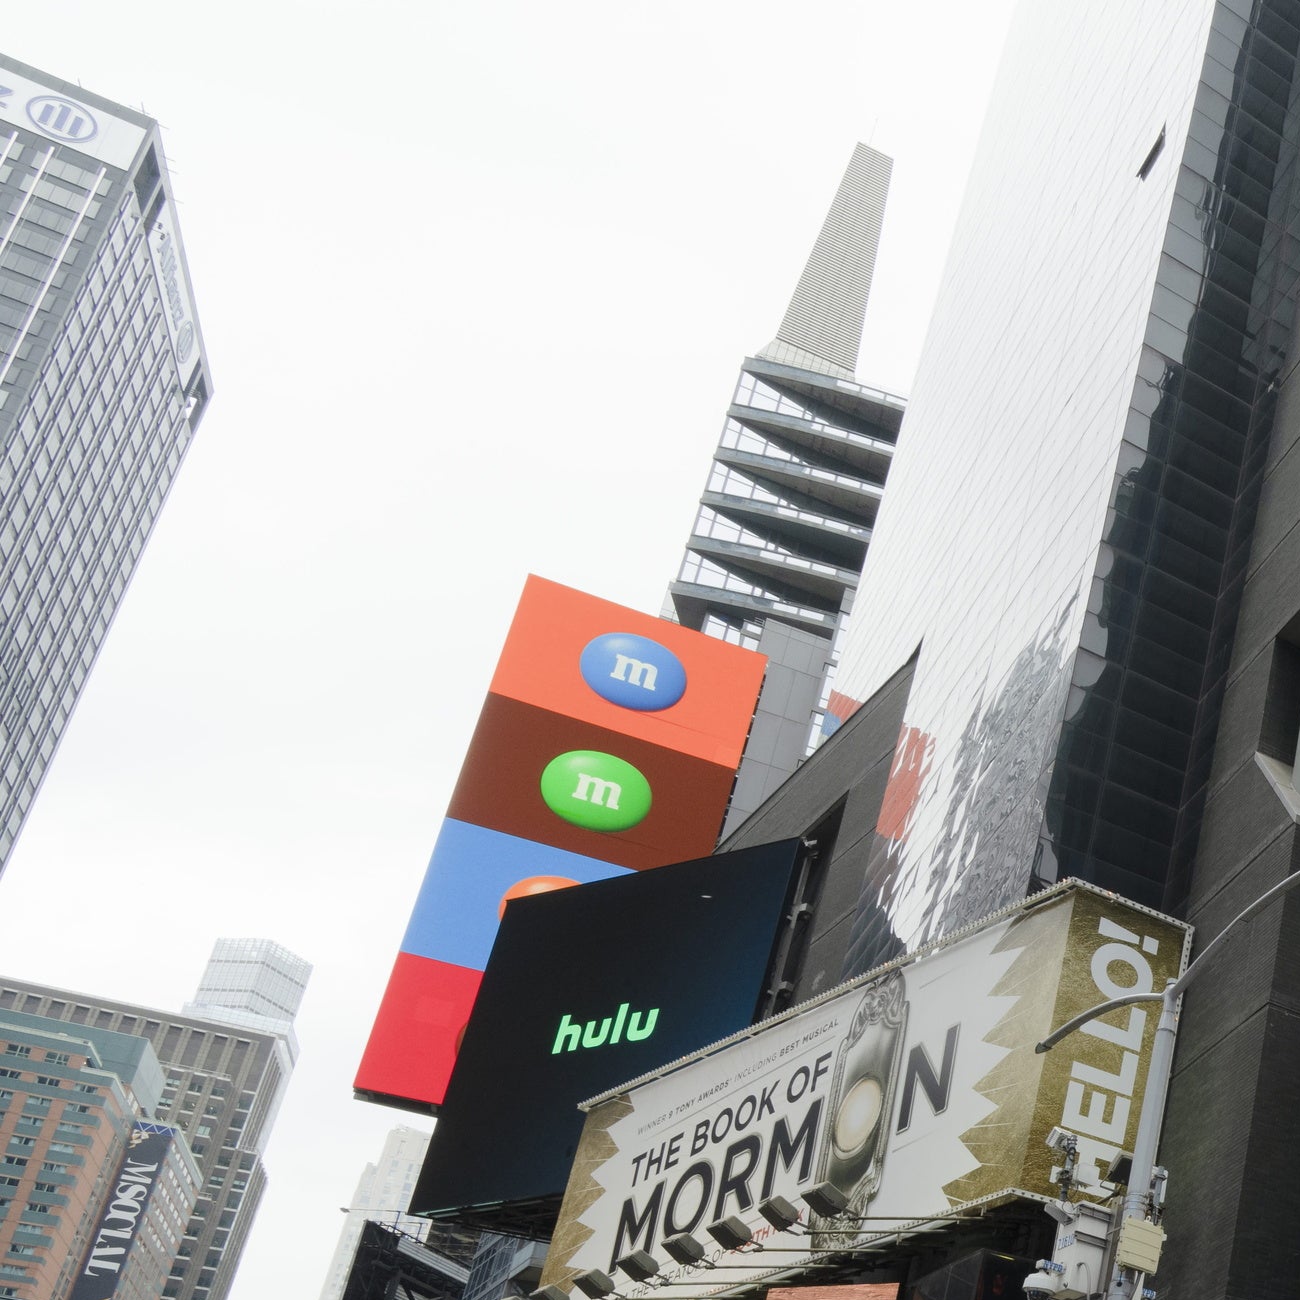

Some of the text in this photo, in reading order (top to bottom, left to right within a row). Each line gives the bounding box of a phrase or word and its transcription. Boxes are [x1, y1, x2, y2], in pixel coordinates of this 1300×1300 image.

[610, 652, 657, 692] m
[571, 770, 623, 811] m
[551, 1002, 660, 1055] hulu
[1050, 916, 1160, 1199] HELLO!
[675, 1098, 697, 1115] TONY
[734, 1054, 778, 1083] INCLUDING
[779, 1040, 801, 1058] BEST
[802, 1018, 839, 1044] MUSICAL
[630, 1051, 833, 1188] THE BOOK OF
